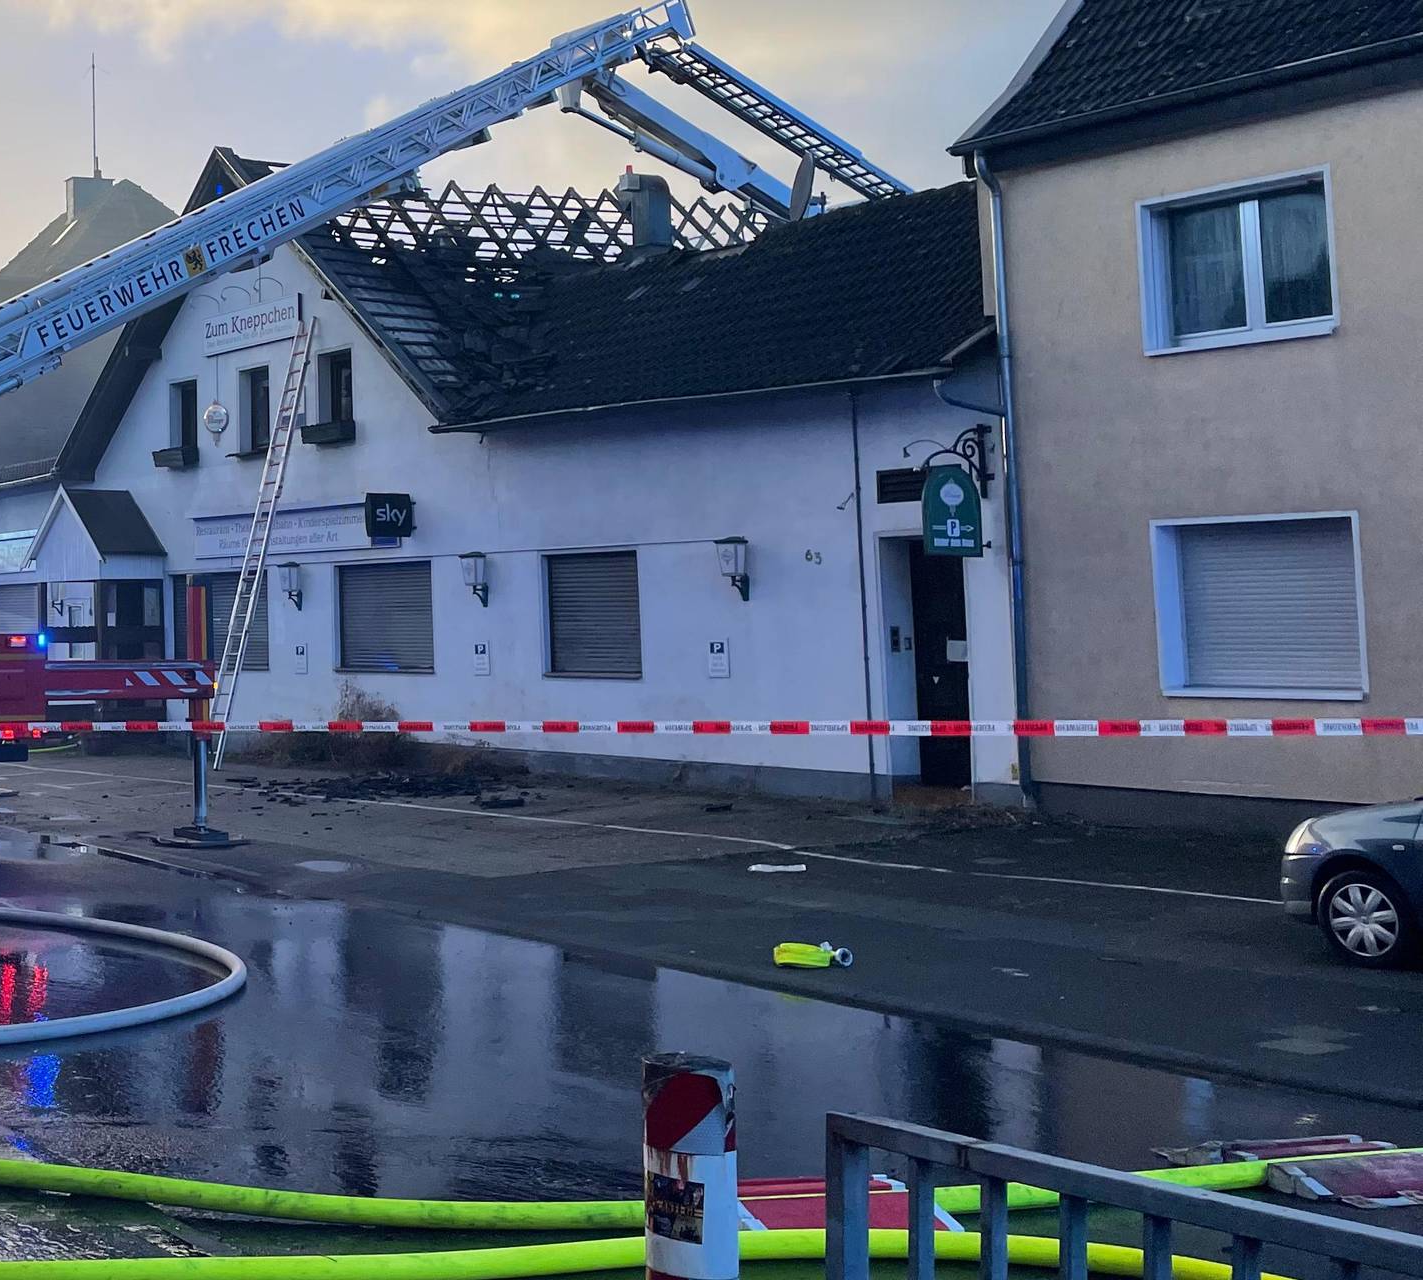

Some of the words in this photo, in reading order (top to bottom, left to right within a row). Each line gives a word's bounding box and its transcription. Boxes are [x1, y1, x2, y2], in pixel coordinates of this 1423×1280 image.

[37, 260, 184, 347] FEUERWEHR
[206, 199, 305, 262] FRECHEN
[205, 321, 228, 339] Zum
[232, 305, 295, 334] Kneppchen
[377, 503, 407, 527] sky
